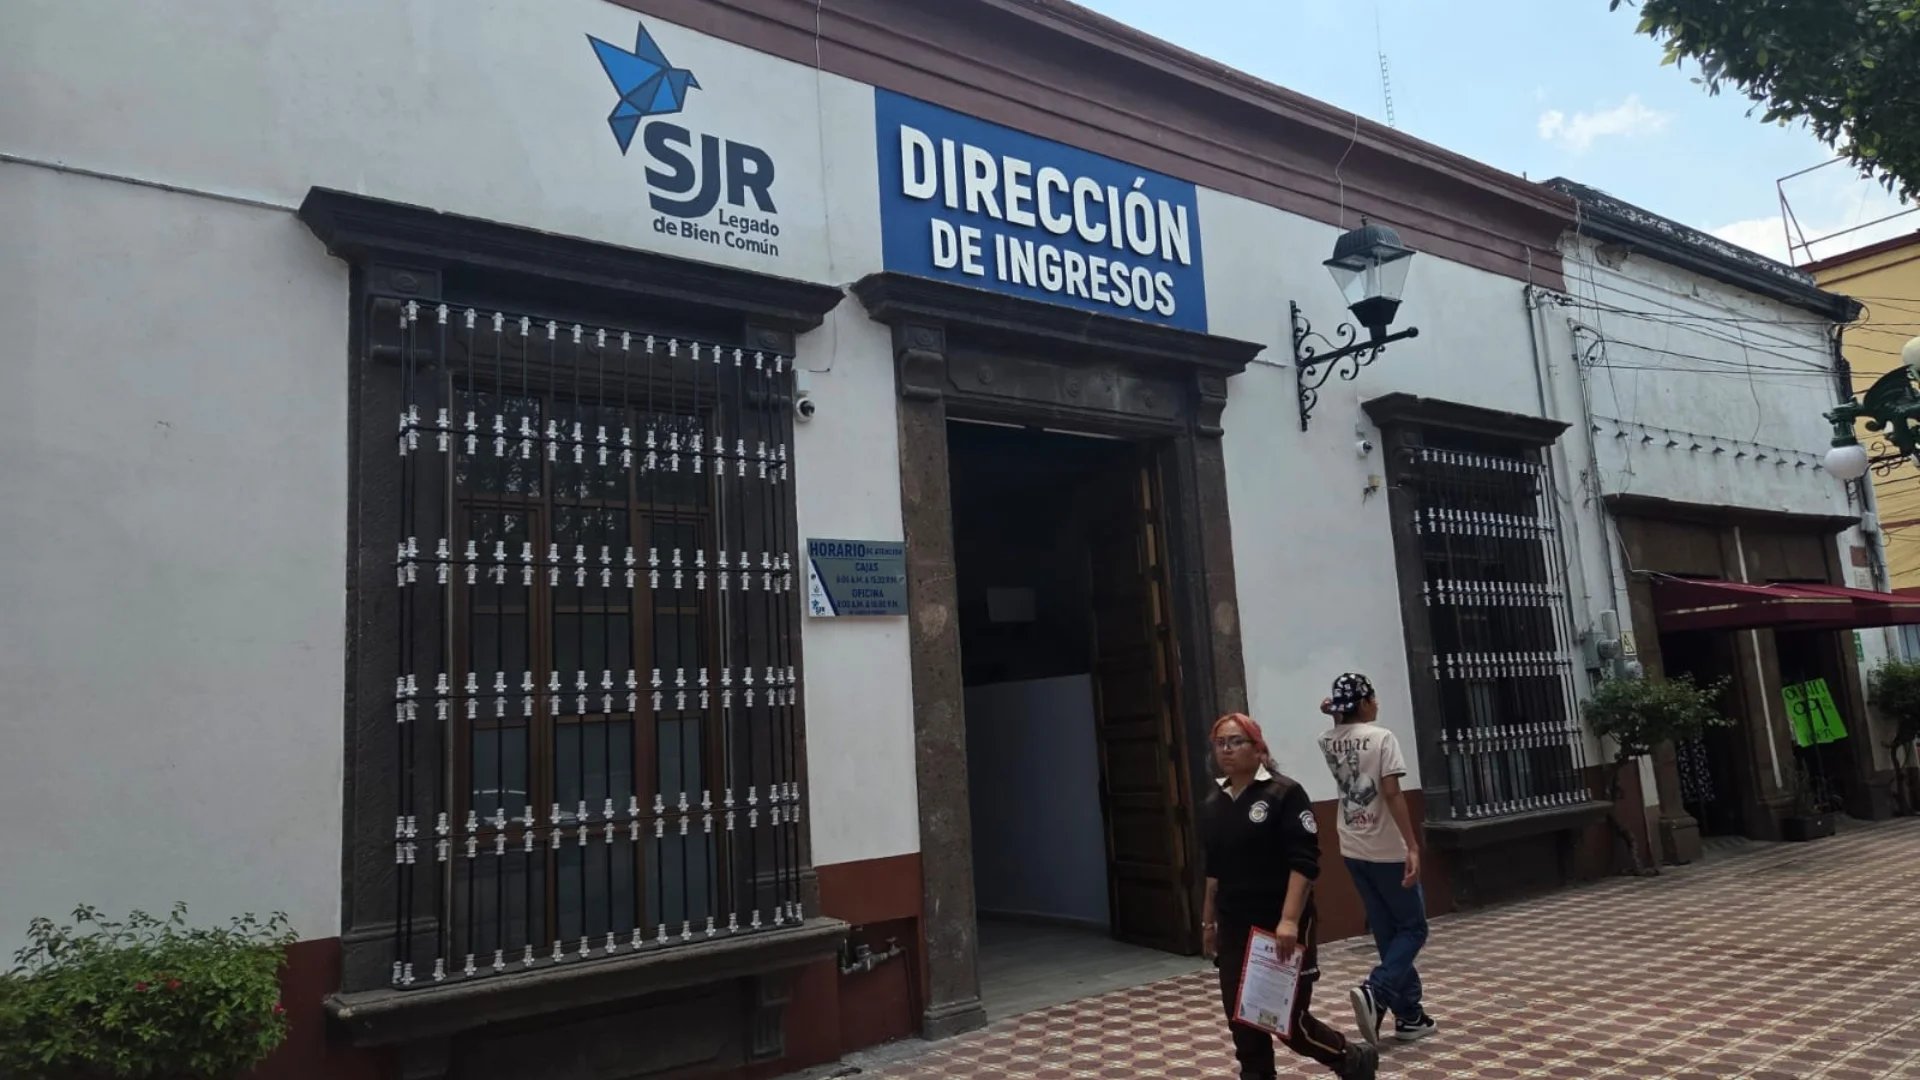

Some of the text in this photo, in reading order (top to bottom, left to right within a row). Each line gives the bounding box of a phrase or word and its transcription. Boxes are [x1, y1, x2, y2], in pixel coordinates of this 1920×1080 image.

[644, 121, 778, 218] SJR
[899, 123, 1192, 266] DIRECCIÓN
[653, 216, 779, 256] de Bien Común
[719, 208, 779, 236] Legado
[930, 217, 1176, 317] DE INGRESOS
[809, 541, 866, 557] HORARIO
[855, 562, 879, 573] CAJAS
[852, 588, 884, 598] OFICINA
